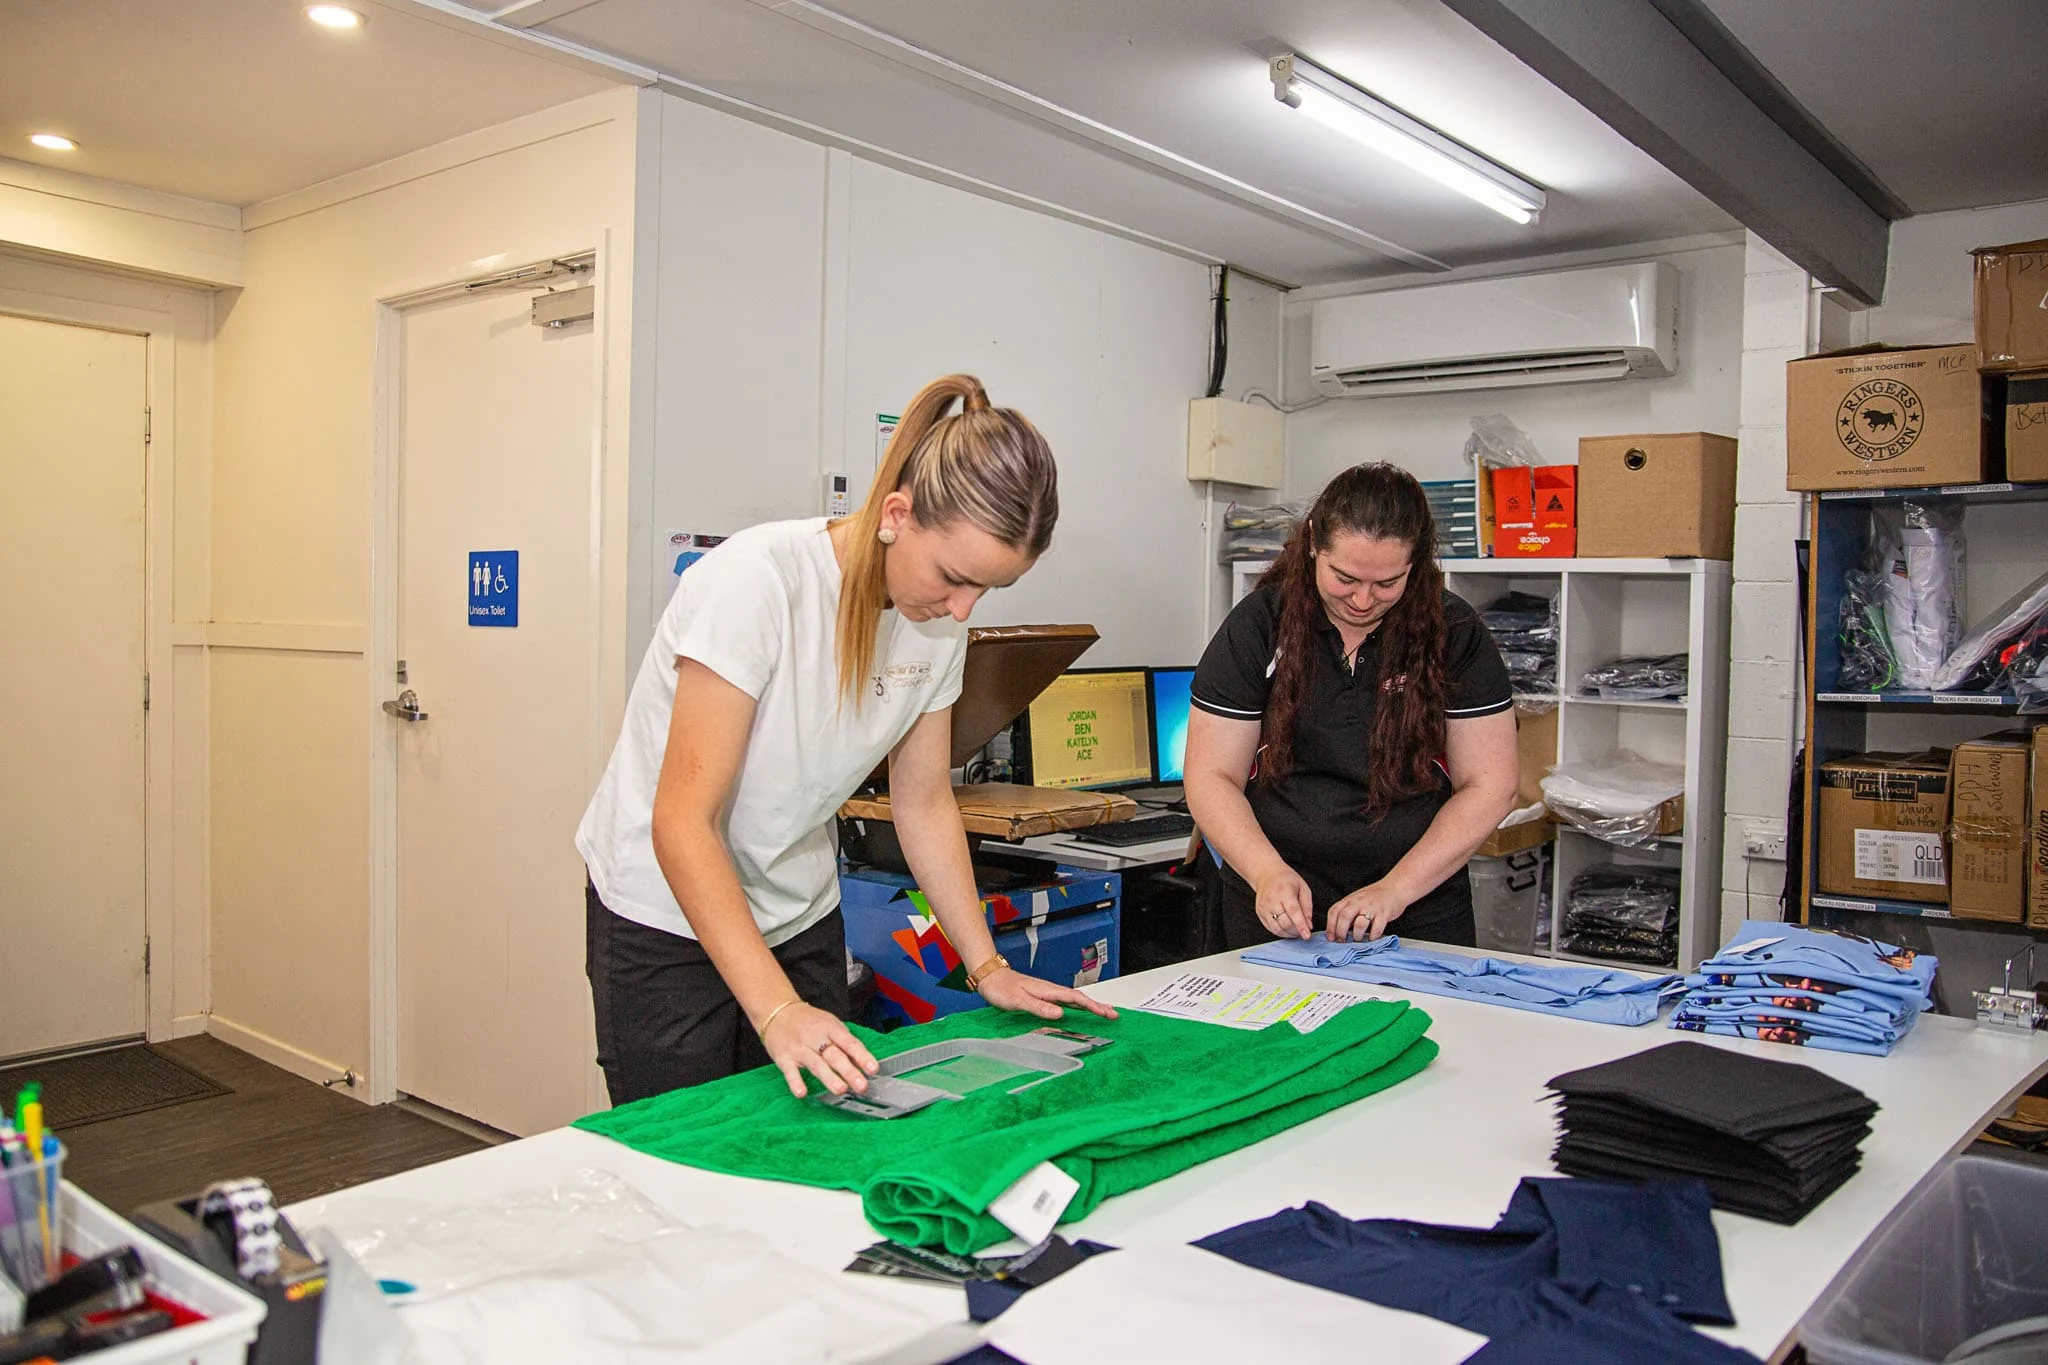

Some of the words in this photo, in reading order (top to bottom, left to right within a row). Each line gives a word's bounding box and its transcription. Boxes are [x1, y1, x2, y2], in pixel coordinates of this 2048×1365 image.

[1843, 381, 1917, 412] RINGERS
[1844, 427, 1917, 459] WESTERN
[1836, 466, 1925, 476] www.ringerswestern.com
[470, 605, 489, 615] Unisex
[490, 605, 505, 615] Toilet
[1067, 710, 1096, 721] JORDAN
[1074, 723, 1091, 735] BEN
[1066, 736, 1098, 748] KATELYN
[1076, 749, 1092, 761] ACE
[1900, 801, 1934, 814] David
[1915, 845, 1942, 861] QLD
